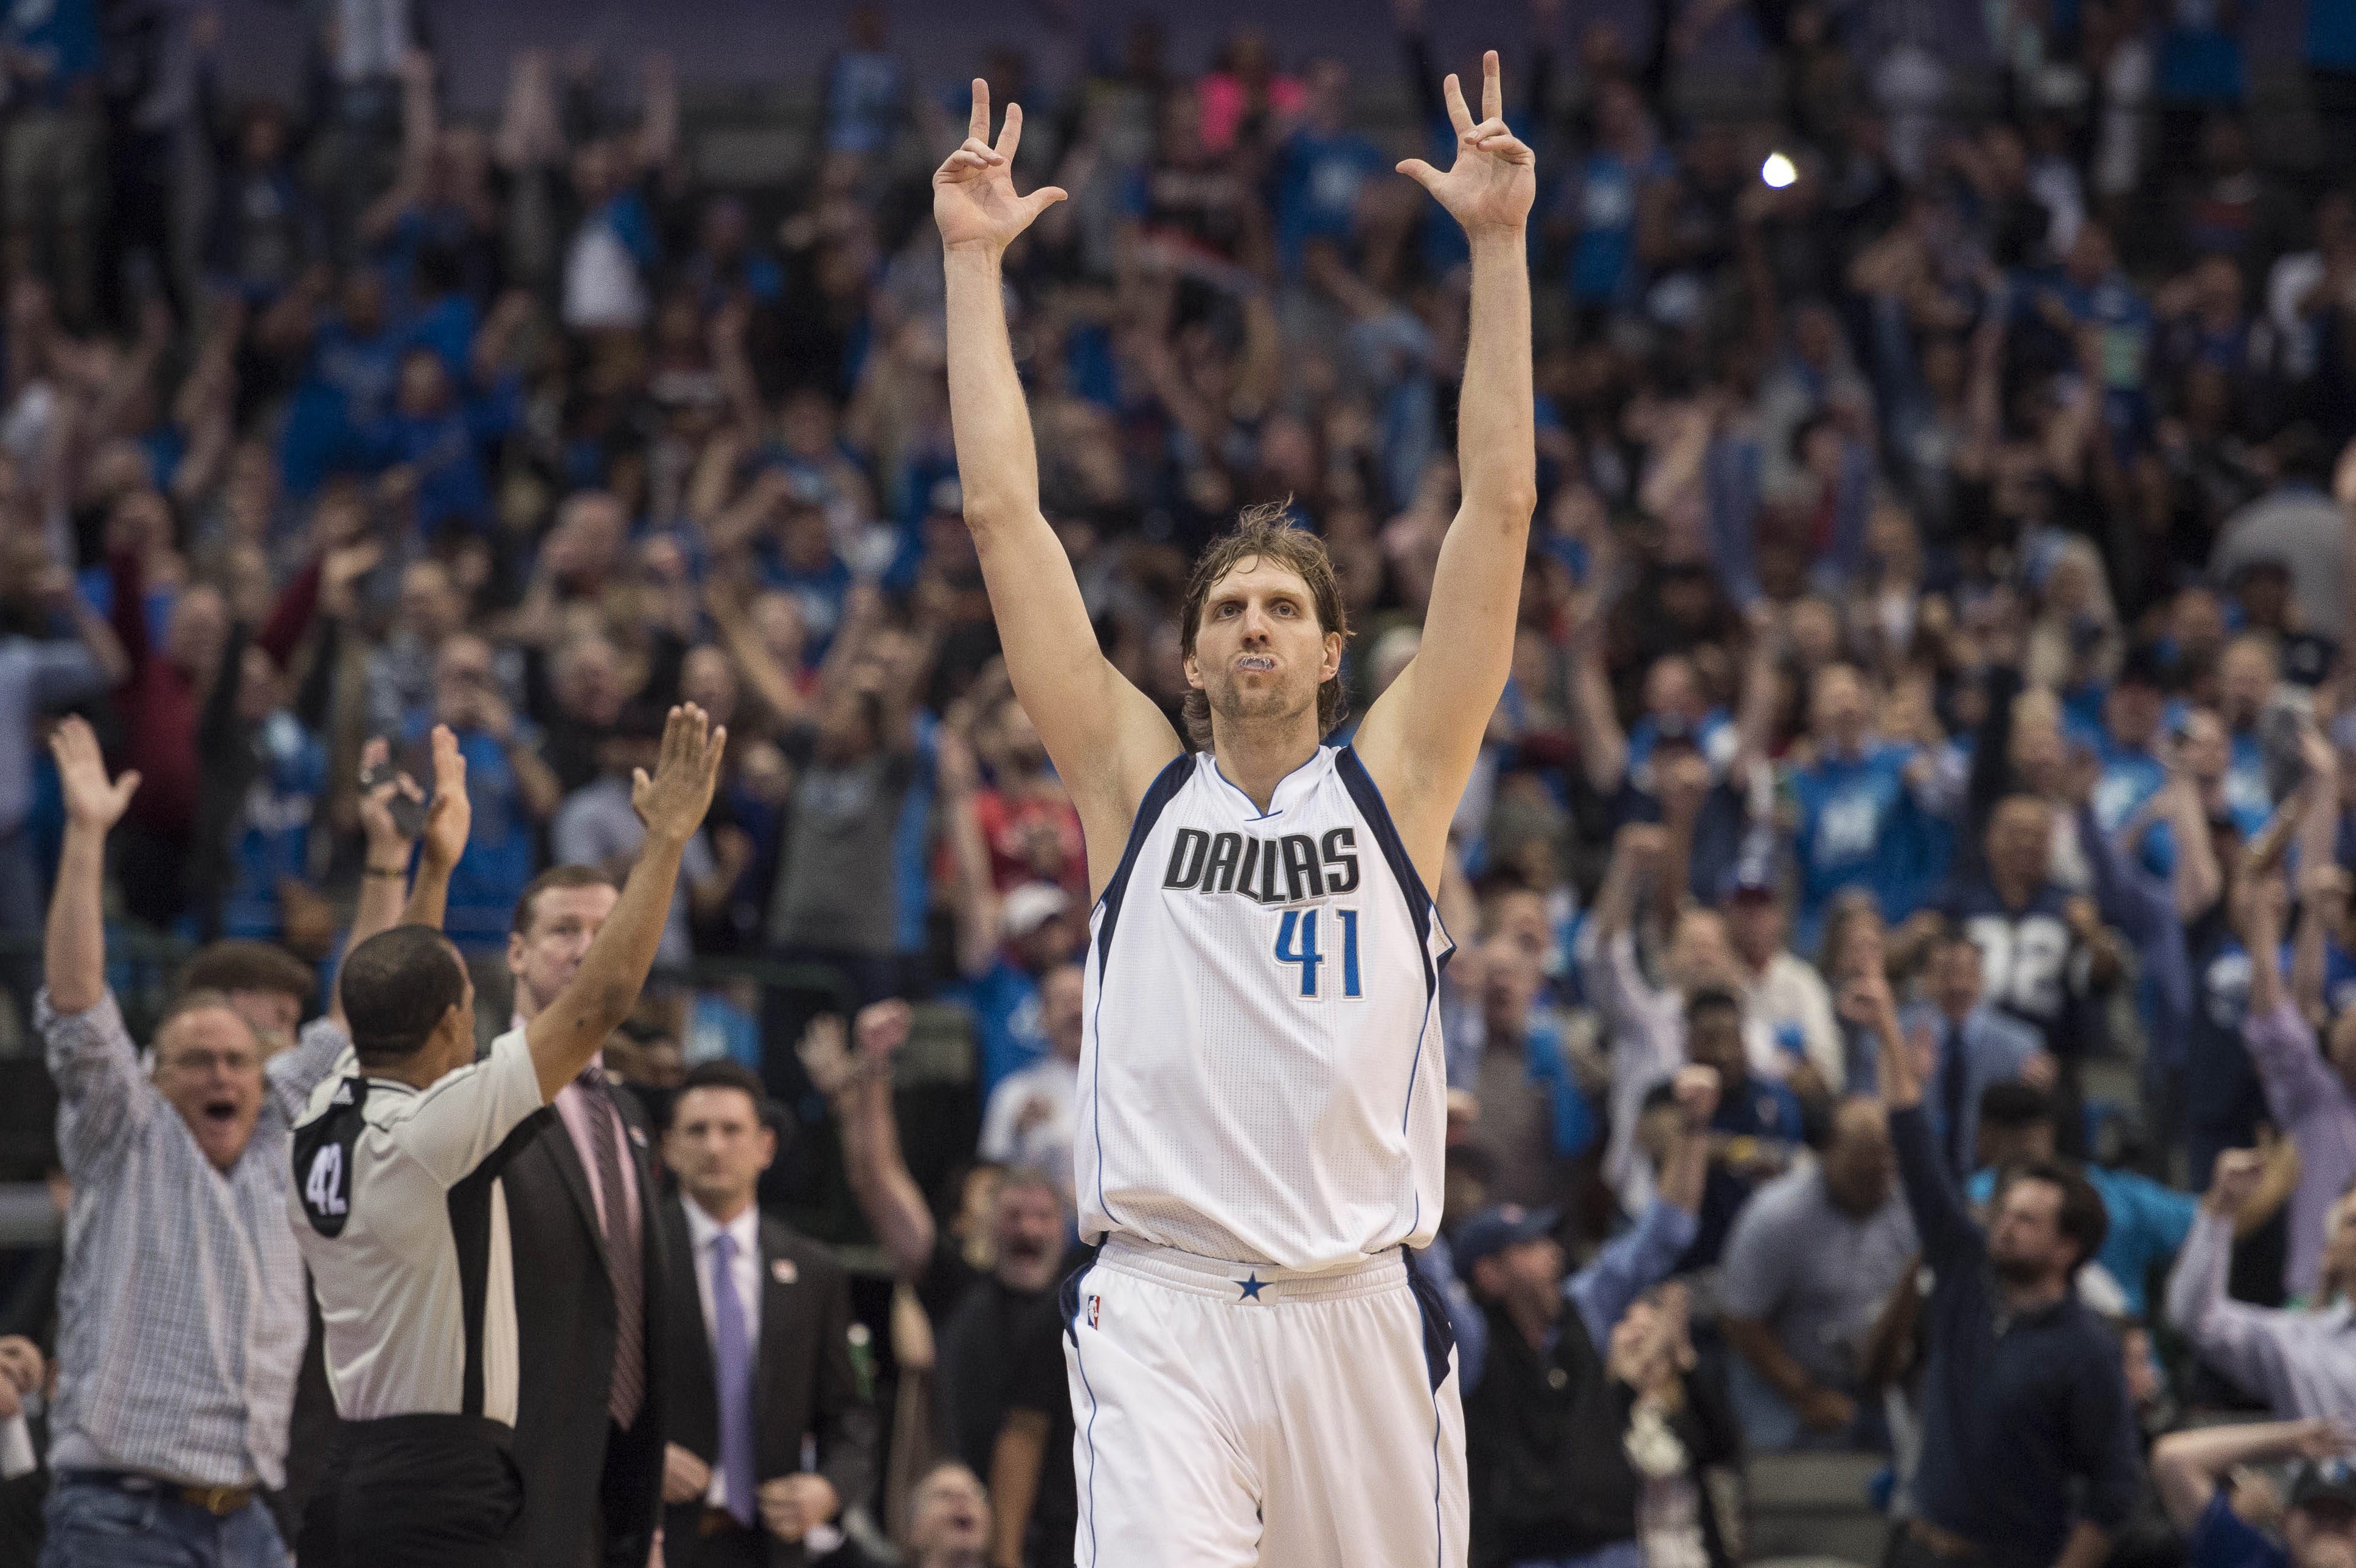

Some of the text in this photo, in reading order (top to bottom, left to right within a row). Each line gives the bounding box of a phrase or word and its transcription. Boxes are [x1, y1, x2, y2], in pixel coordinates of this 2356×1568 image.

[1162, 826, 1360, 904] DALLAS
[1274, 909, 1362, 999] 41
[306, 1141, 347, 1215] 42
